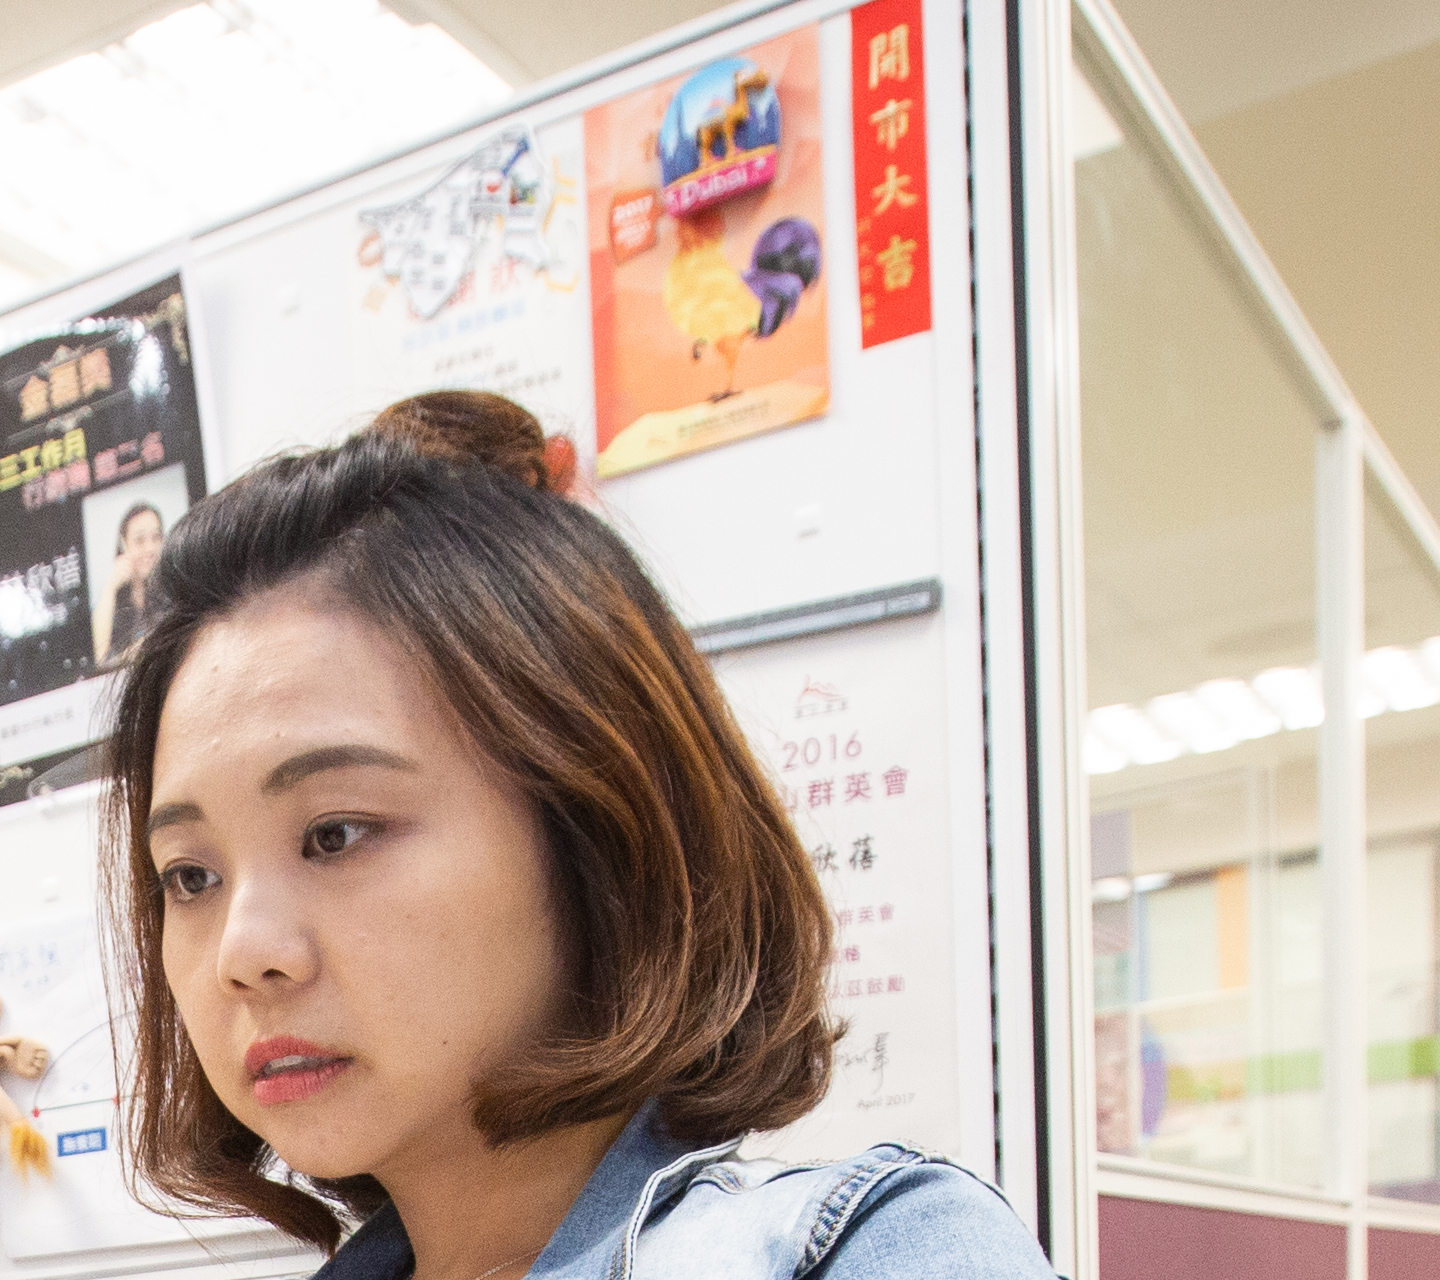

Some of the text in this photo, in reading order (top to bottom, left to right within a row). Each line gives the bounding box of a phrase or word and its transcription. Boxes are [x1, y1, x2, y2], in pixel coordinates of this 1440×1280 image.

[868, 22, 919, 293] 開市大吉
[681, 167, 748, 210] Dubai
[782, 729, 863, 772] 2016
